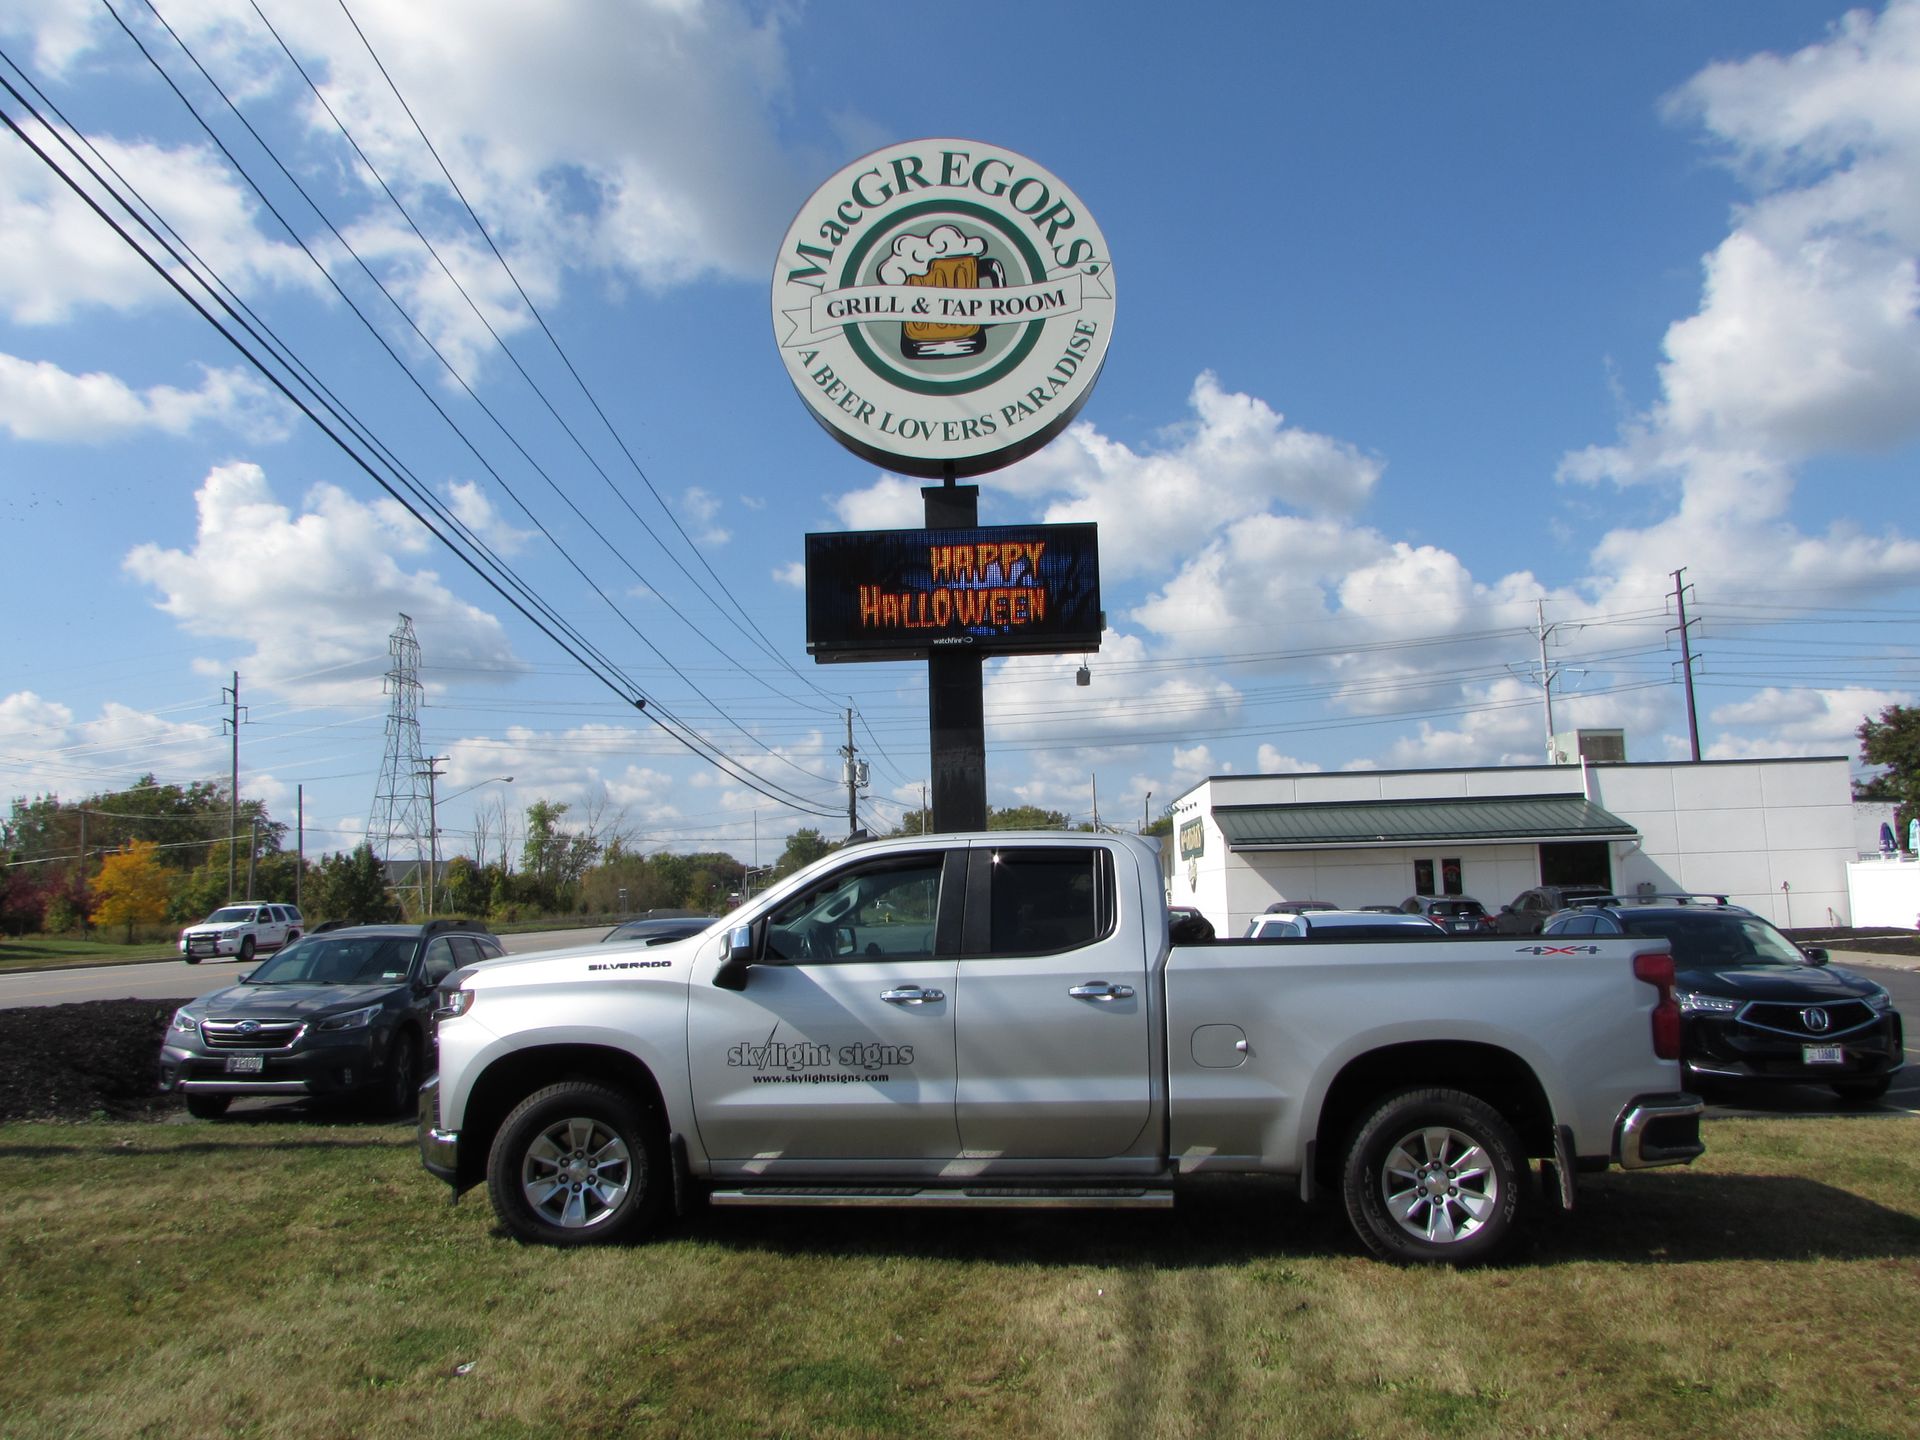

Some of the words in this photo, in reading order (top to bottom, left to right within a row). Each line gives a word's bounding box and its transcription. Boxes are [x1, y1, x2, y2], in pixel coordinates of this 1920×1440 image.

[786, 152, 1101, 292] MacGREGORS'
[826, 296, 905, 318] GRILL
[911, 297, 930, 314] &
[938, 298, 983, 316] TAP
[990, 289, 1067, 316] ROOM
[798, 349, 817, 368] A
[811, 364, 876, 425] BEER
[879, 414, 998, 442] LOVERS
[1000, 319, 1098, 427] PARADISE
[930, 541, 1046, 583] HAPPY
[859, 584, 1047, 628] HALLOWEEN
[588, 960, 672, 971] SILVERADO
[727, 1019, 831, 1071] skylight
[838, 1042, 914, 1070] signs
[752, 1073, 889, 1085] www.skylightsigns.com
